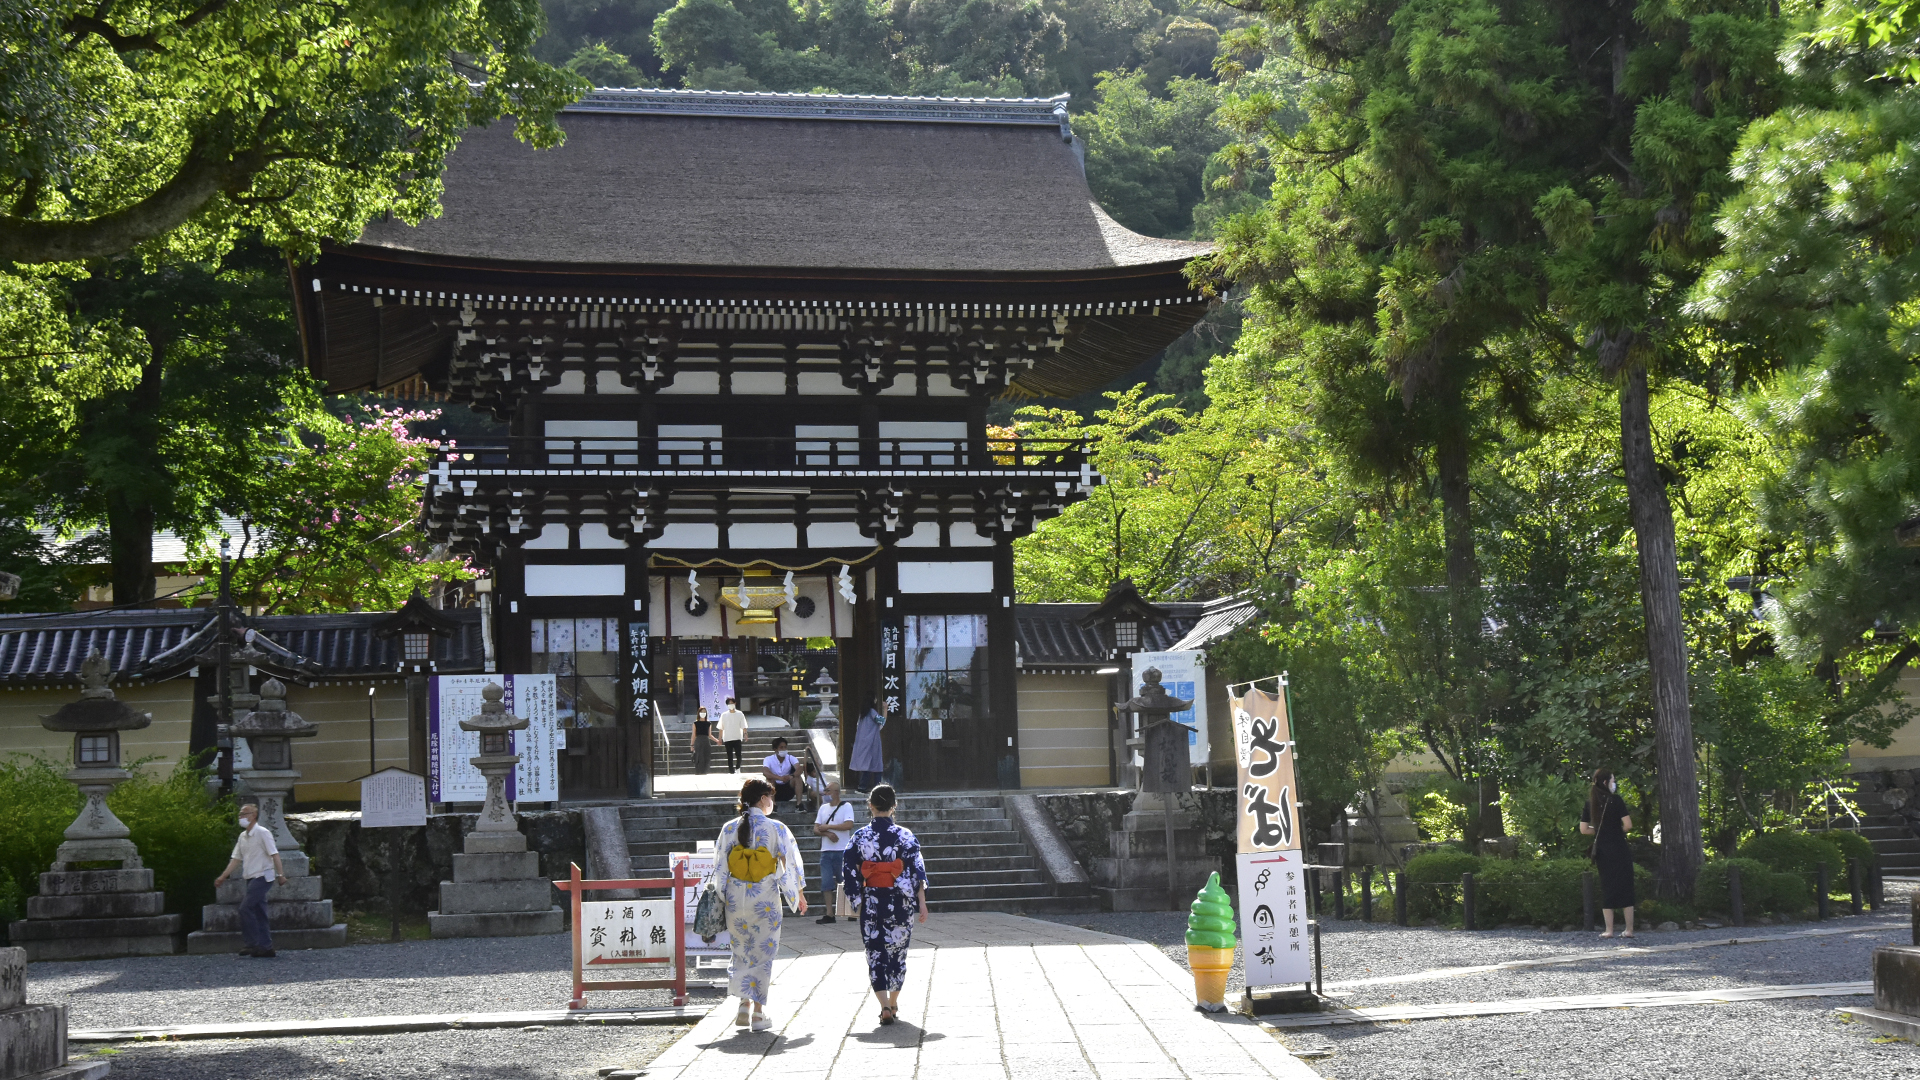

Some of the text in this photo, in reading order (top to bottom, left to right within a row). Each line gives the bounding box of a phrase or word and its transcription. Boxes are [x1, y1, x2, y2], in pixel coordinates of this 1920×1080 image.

[630, 629, 639, 658] 午前十時
[640, 629, 648, 657] 九月四日
[892, 626, 900, 651] 九月一日
[631, 660, 650, 718] 八朔祭
[884, 652, 900, 713] 月次祭
[604, 906, 652, 920] お酒の
[1286, 871, 1299, 952] 参詣者休憩所
[590, 925, 667, 947] 資料館
